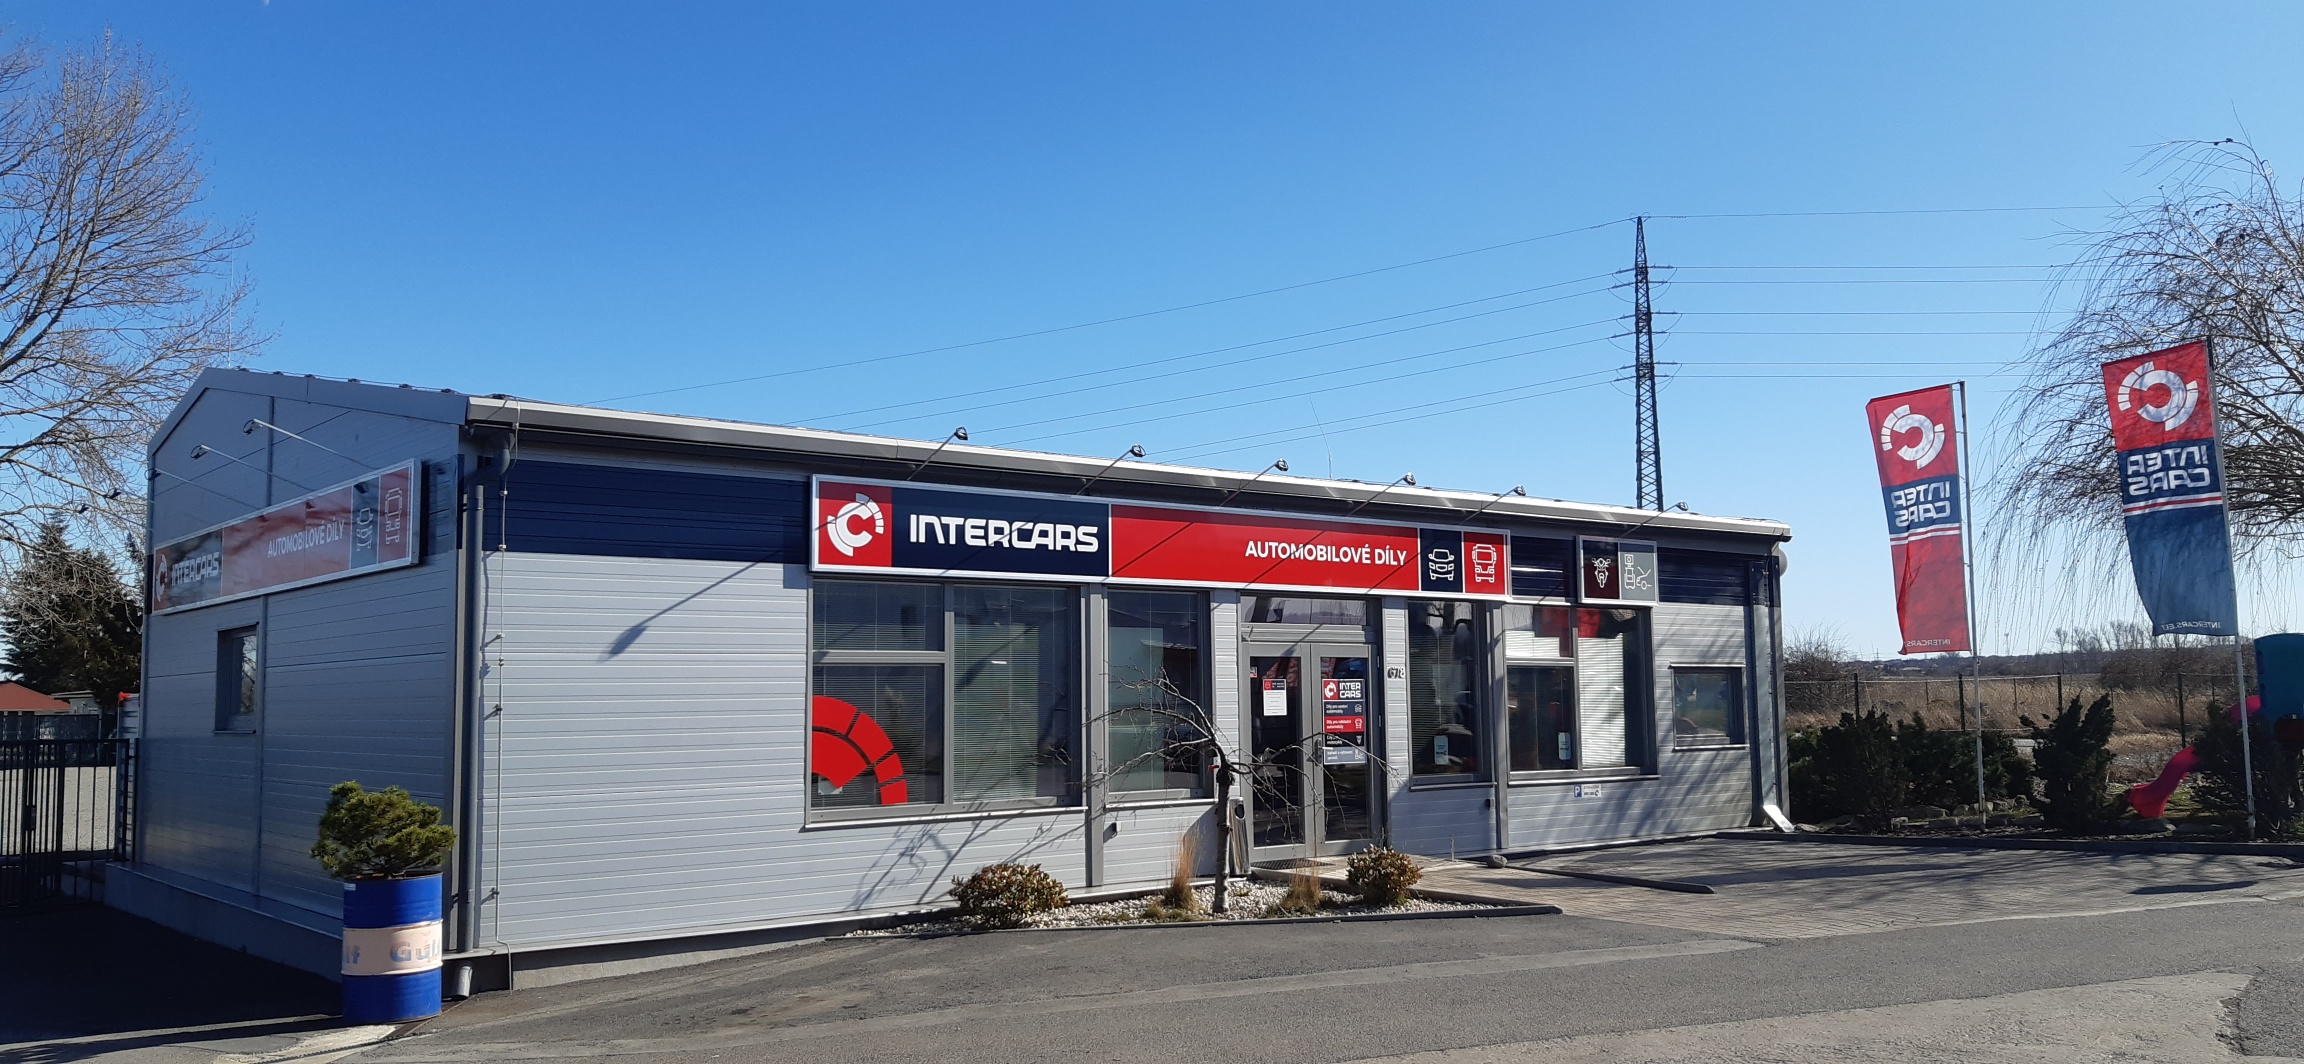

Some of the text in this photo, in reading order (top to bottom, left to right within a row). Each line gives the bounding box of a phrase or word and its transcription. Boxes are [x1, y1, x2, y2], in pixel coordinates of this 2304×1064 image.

[267, 517, 345, 558] AUTOMOBILOVÉ DÍLY
[910, 514, 1099, 553] INTERCARS
[1245, 540, 1407, 566] AUTOMOBILOVÉ DÍLY
[171, 551, 220, 587] INTERCARS
[1339, 682, 1361, 690] INTER
[1339, 690, 1361, 698] CARS
